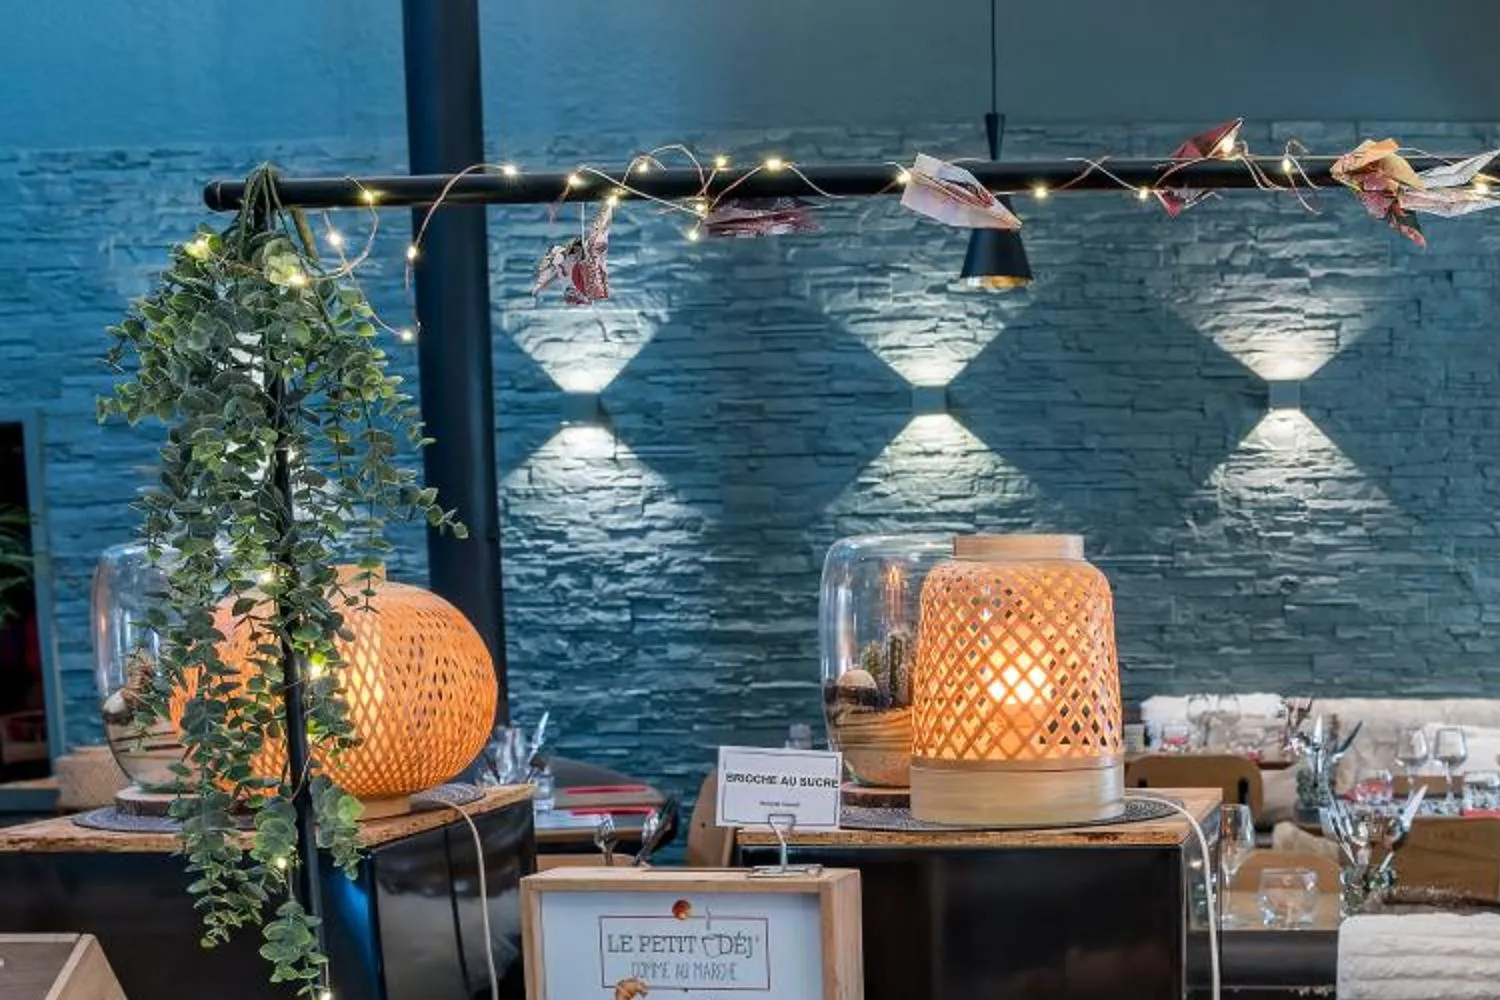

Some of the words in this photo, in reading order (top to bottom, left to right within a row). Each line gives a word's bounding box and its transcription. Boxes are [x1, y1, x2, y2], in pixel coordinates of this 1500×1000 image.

[780, 775, 797, 787] AU
[607, 934, 634, 953] LE
[639, 934, 696, 954] PETIT
